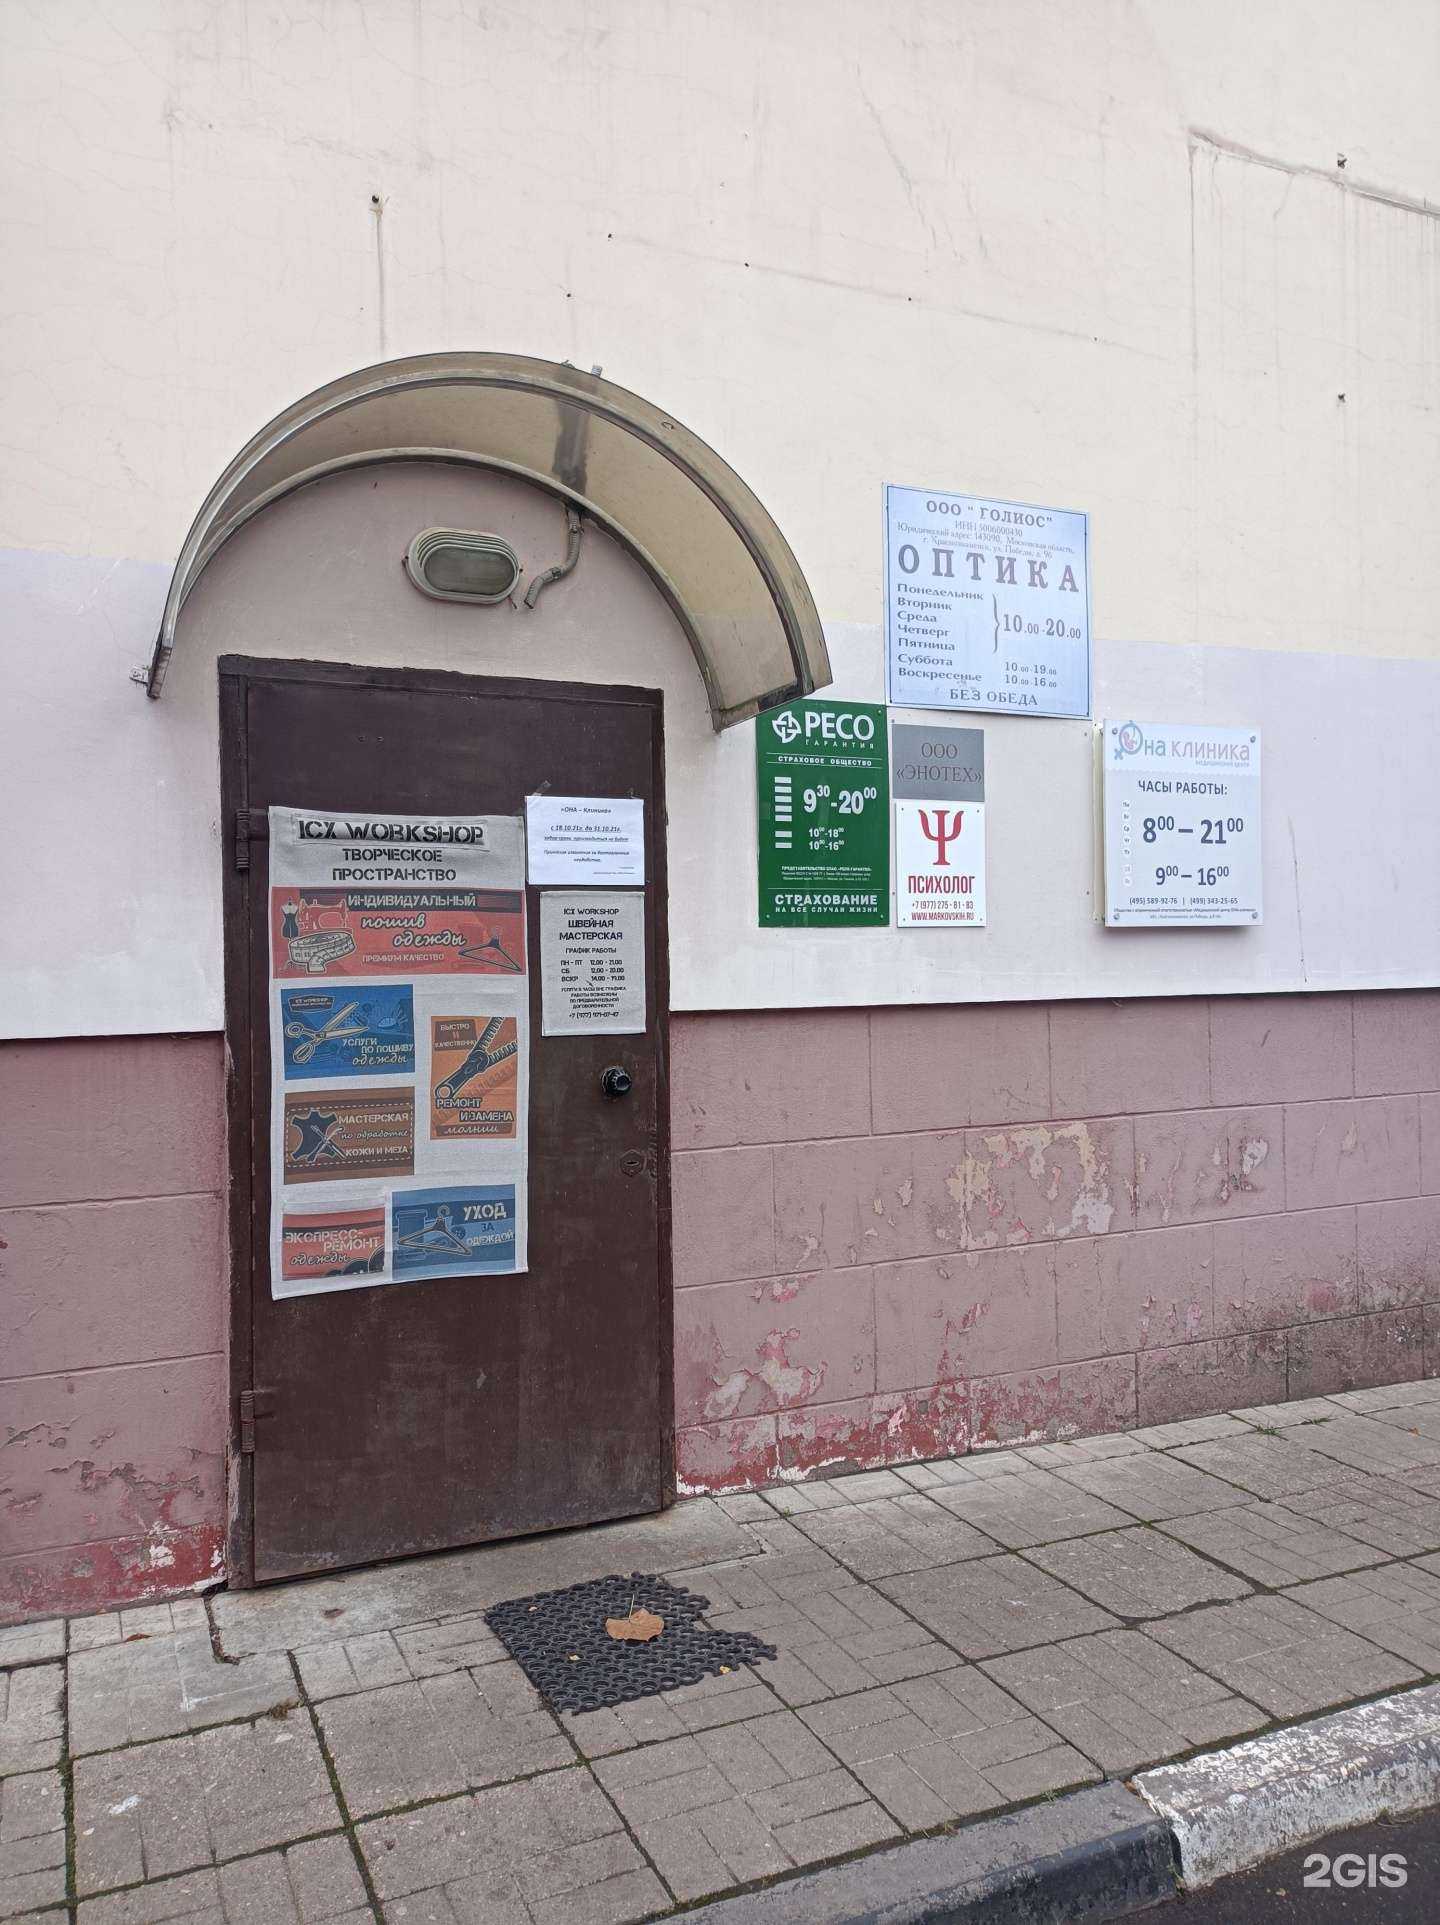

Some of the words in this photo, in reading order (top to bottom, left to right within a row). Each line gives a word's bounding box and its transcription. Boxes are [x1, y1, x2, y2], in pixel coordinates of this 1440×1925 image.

[926, 500, 961, 515] ООО
[898, 544, 1080, 592] ОПТИКА
[897, 583, 984, 600] Понедельник
[897, 597, 952, 612] Вторник
[897, 610, 937, 623] Среда
[898, 624, 950, 638] Четверг
[898, 637, 956, 651] Пятница
[898, 653, 953, 667] Суббота
[898, 667, 983, 682] Воскресенье
[950, 688, 981, 702] БЕЗ
[986, 690, 1038, 706] ОБЕДА
[805, 711, 874, 740] РЕСО
[805, 740, 874, 750] ГАРАНТИЯ
[920, 742, 958, 760] ООО
[1172, 740, 1250, 761] клиника
[778, 756, 825, 764] СТРАХОВОЕ
[830, 758, 872, 766] ОБЩЕСТВО
[896, 764, 982, 784] «ЭНОТЕХ»
[1138, 780, 1172, 793] ЧАСЫ
[1176, 782, 1228, 796] РАБОТЫ:
[298, 820, 337, 840] ICX
[344, 822, 484, 843] WORKSHOP
[342, 848, 442, 862] ТВОРЧЕСКОЕ
[332, 868, 456, 882] ПРОСТРАНСТВО
[908, 875, 975, 894] ПСИХОЛОГ
[347, 892, 476, 909] ИНДИВИДУАЛЬНЫЙ
[774, 894, 878, 905] СТРАХОВАНИЕ
[361, 912, 426, 929] пошив
[568, 918, 614, 928] ШВЕЙНАЯ
[392, 930, 466, 948] одежды
[560, 932, 623, 940] МАСТЕРСКАЯ
[402, 953, 444, 962] КАЧЕСТВО
[342, 1038, 378, 1047] УСЛУГИ
[361, 1046, 374, 1054] ПО
[352, 1055, 408, 1066] одежды
[436, 1098, 481, 1108] РЕМОНТ
[338, 1114, 408, 1124] МАСТЕРСКАЯ
[346, 1148, 374, 1157] КОЖИ
[385, 1146, 408, 1155] МЕХА
[463, 1202, 508, 1220] УХОД
[481, 1222, 494, 1232] ЗА
[323, 1236, 380, 1252] РЕМОНТ
[466, 1231, 516, 1247] ОДЕЖДОЙ
[290, 1251, 350, 1265] одежды
